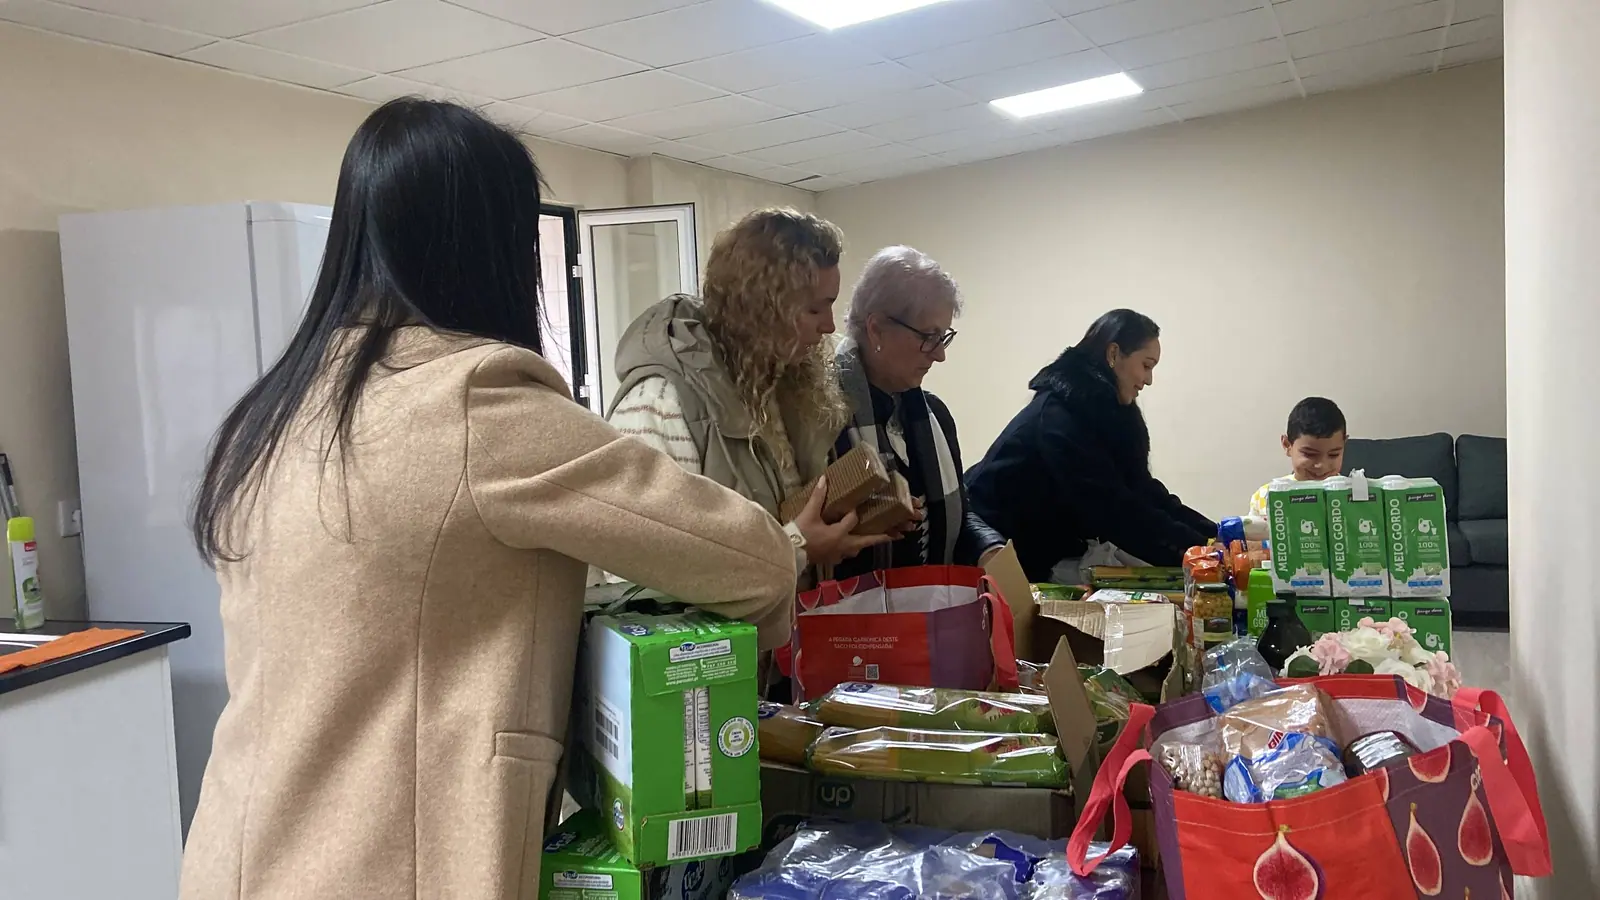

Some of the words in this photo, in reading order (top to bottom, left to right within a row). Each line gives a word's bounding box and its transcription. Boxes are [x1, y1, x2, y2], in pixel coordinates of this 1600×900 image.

[1274, 500, 1286, 541] GORDO
[1331, 499, 1343, 540] GORDO
[1390, 498, 1402, 540] GORDO
[1277, 542, 1288, 572] MEIO
[1334, 542, 1346, 572] MEIO
[1359, 541, 1379, 549] 100%
[1393, 542, 1405, 572] MEIO
[1418, 541, 1438, 549] 100%
[821, 786, 851, 807] up
